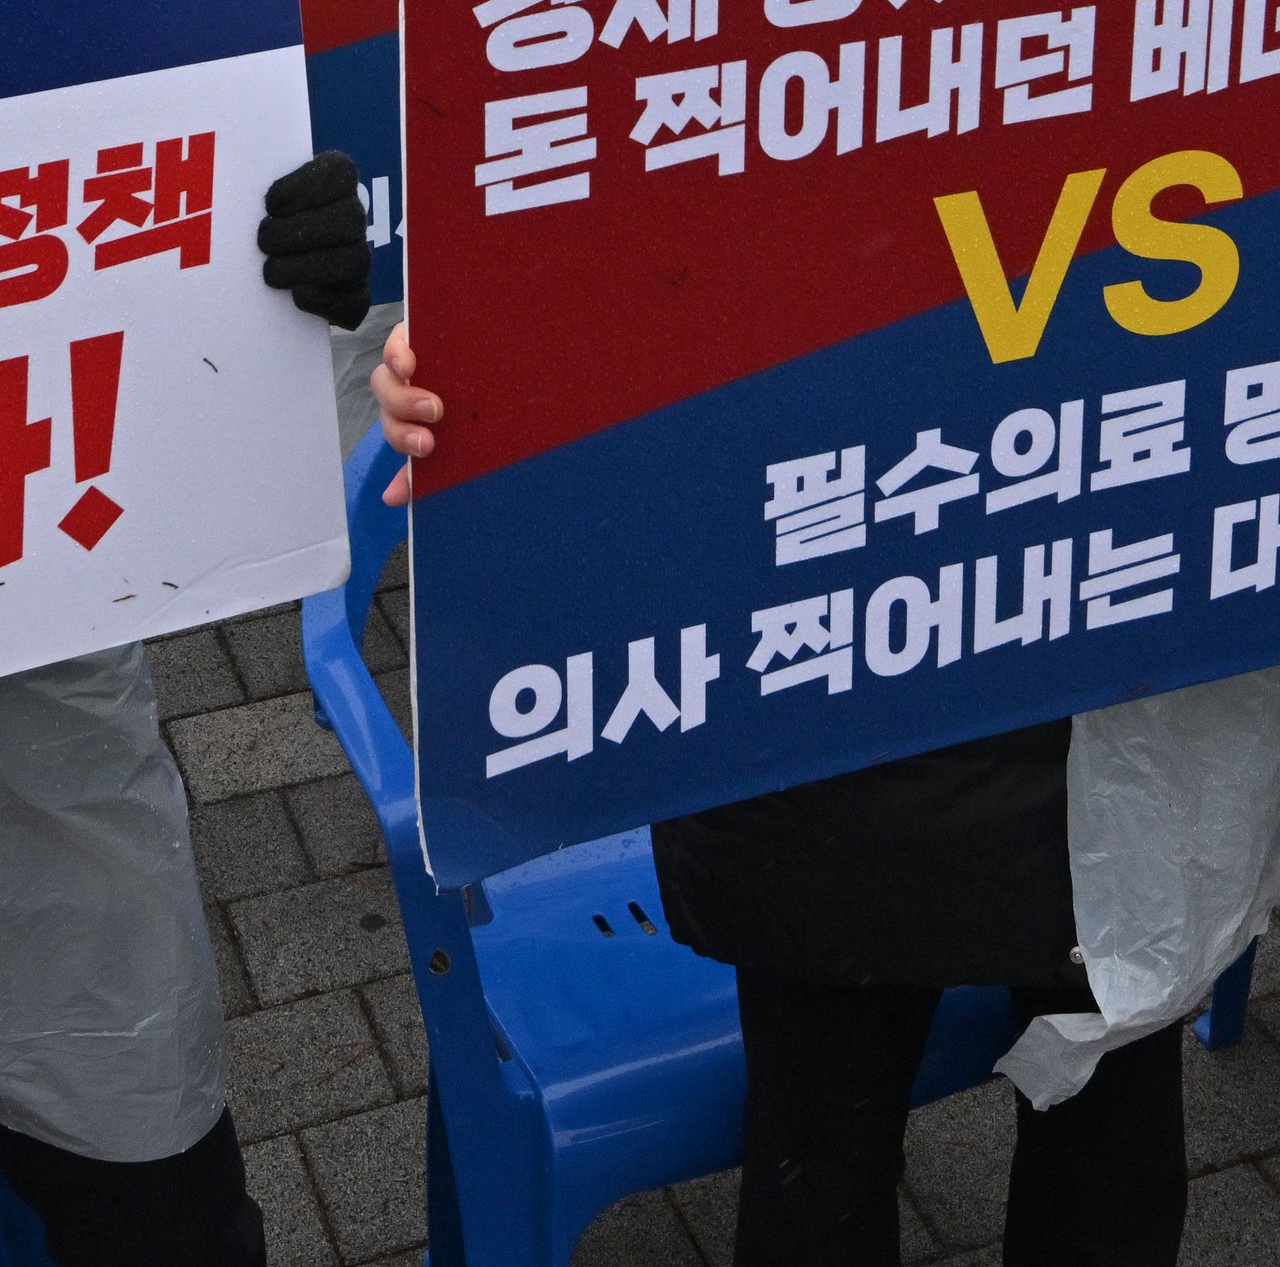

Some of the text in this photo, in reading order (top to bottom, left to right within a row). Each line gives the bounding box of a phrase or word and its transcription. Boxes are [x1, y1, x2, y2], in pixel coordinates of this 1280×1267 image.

[474, 85, 598, 219] 돈
[628, 4, 1098, 177] 찍어내던
[932, 148, 1244, 366] VS
[763, 378, 1192, 567] 필수의료
[484, 622, 721, 780] 의사
[744, 528, 1182, 698] 찍어내는
